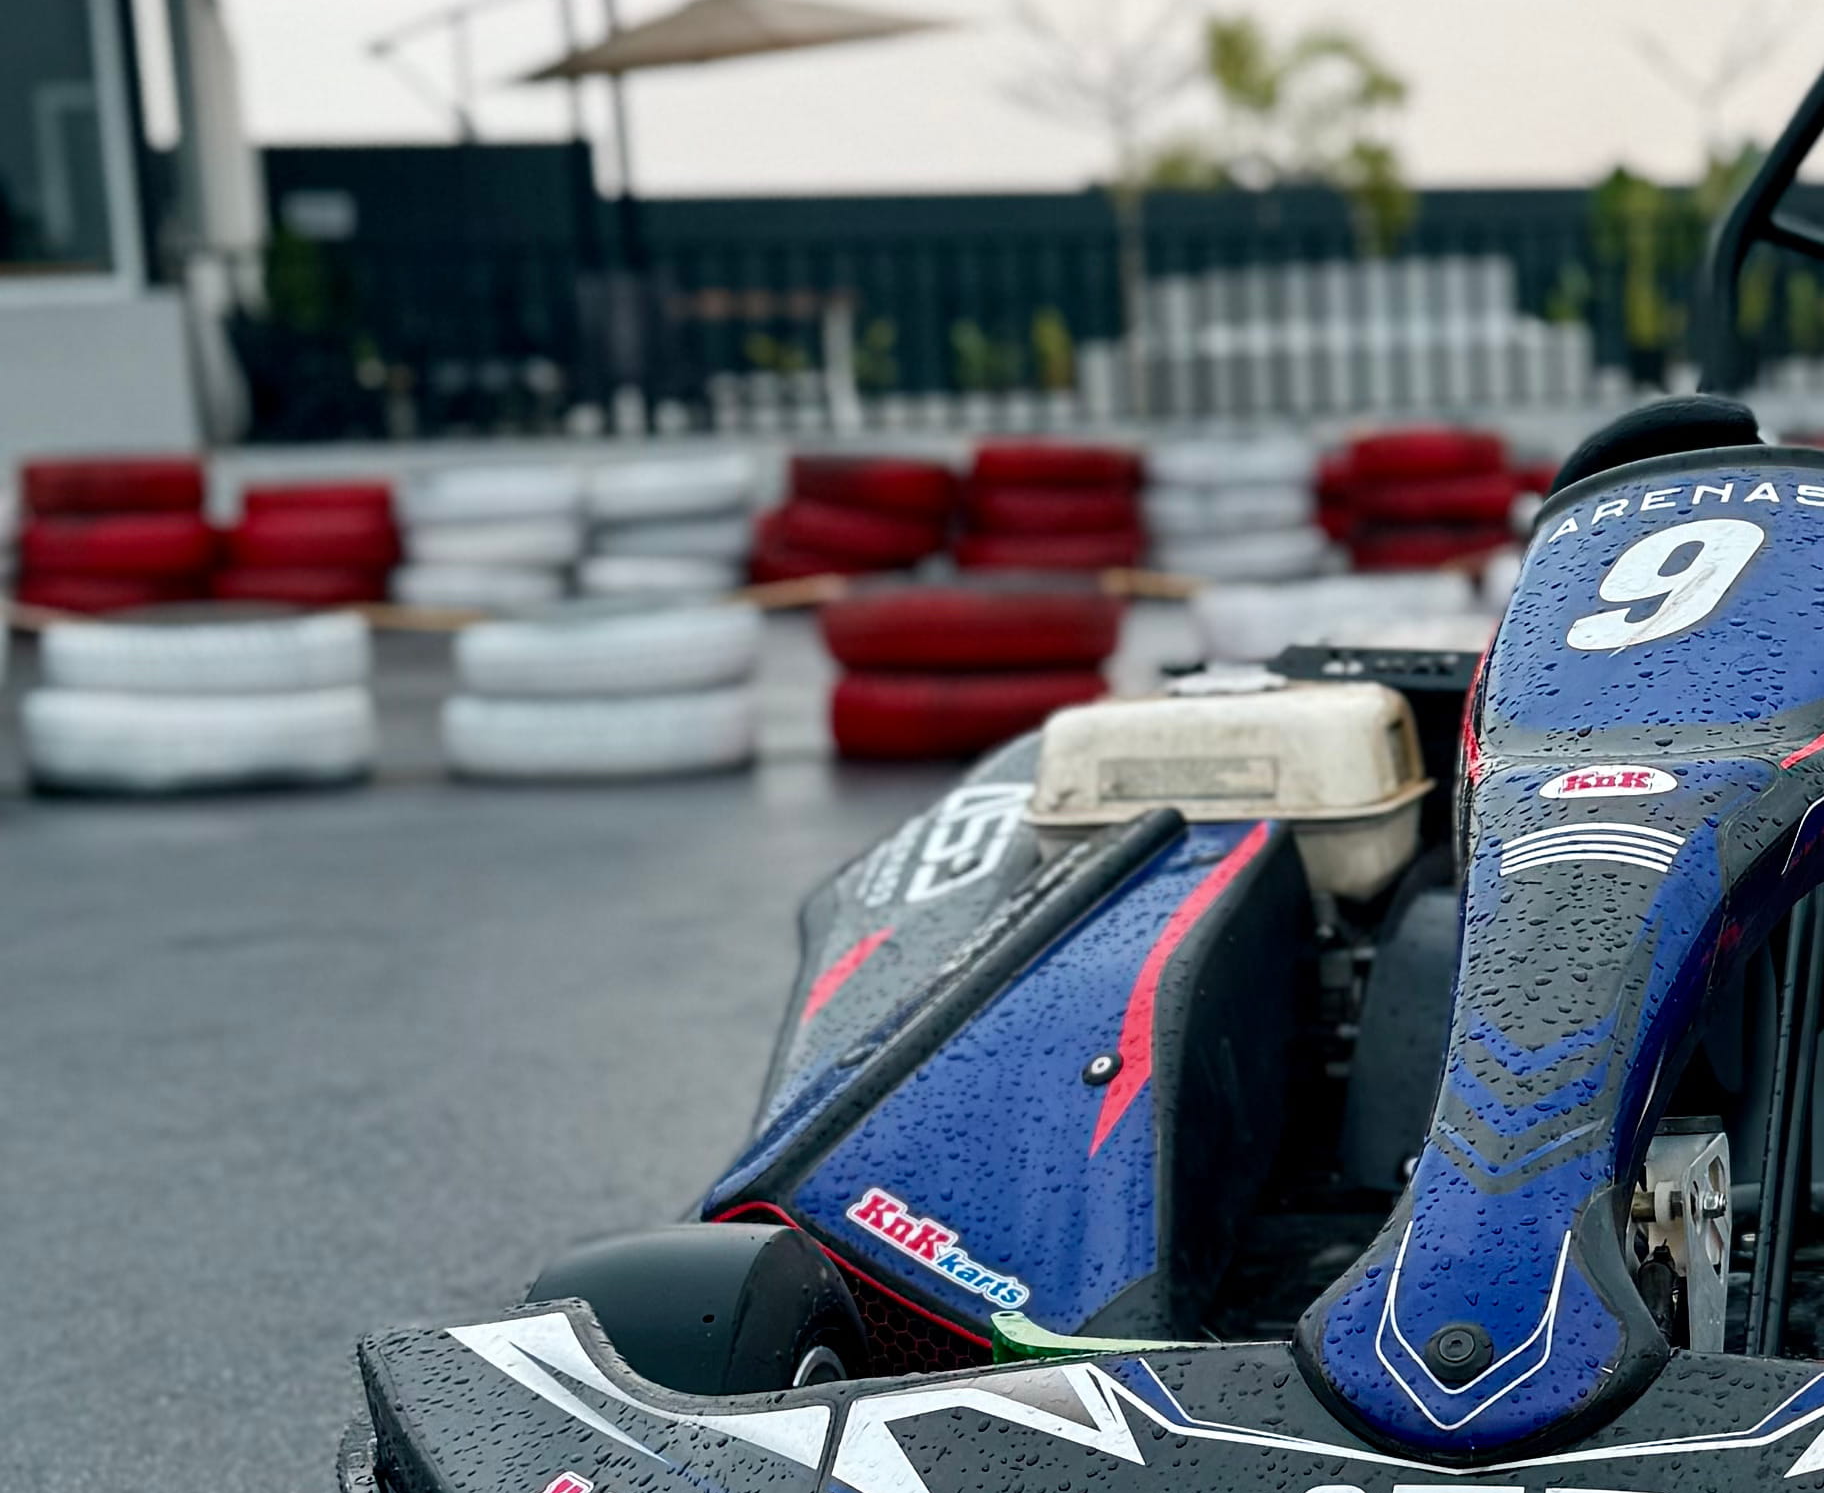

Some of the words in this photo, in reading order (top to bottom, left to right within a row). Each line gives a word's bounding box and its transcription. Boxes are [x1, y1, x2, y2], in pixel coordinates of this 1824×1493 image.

[1566, 518, 1765, 650] 9
[1559, 771, 1652, 793] KnK
[854, 1194, 950, 1261] KnK
[937, 1253, 1023, 1303] karts
